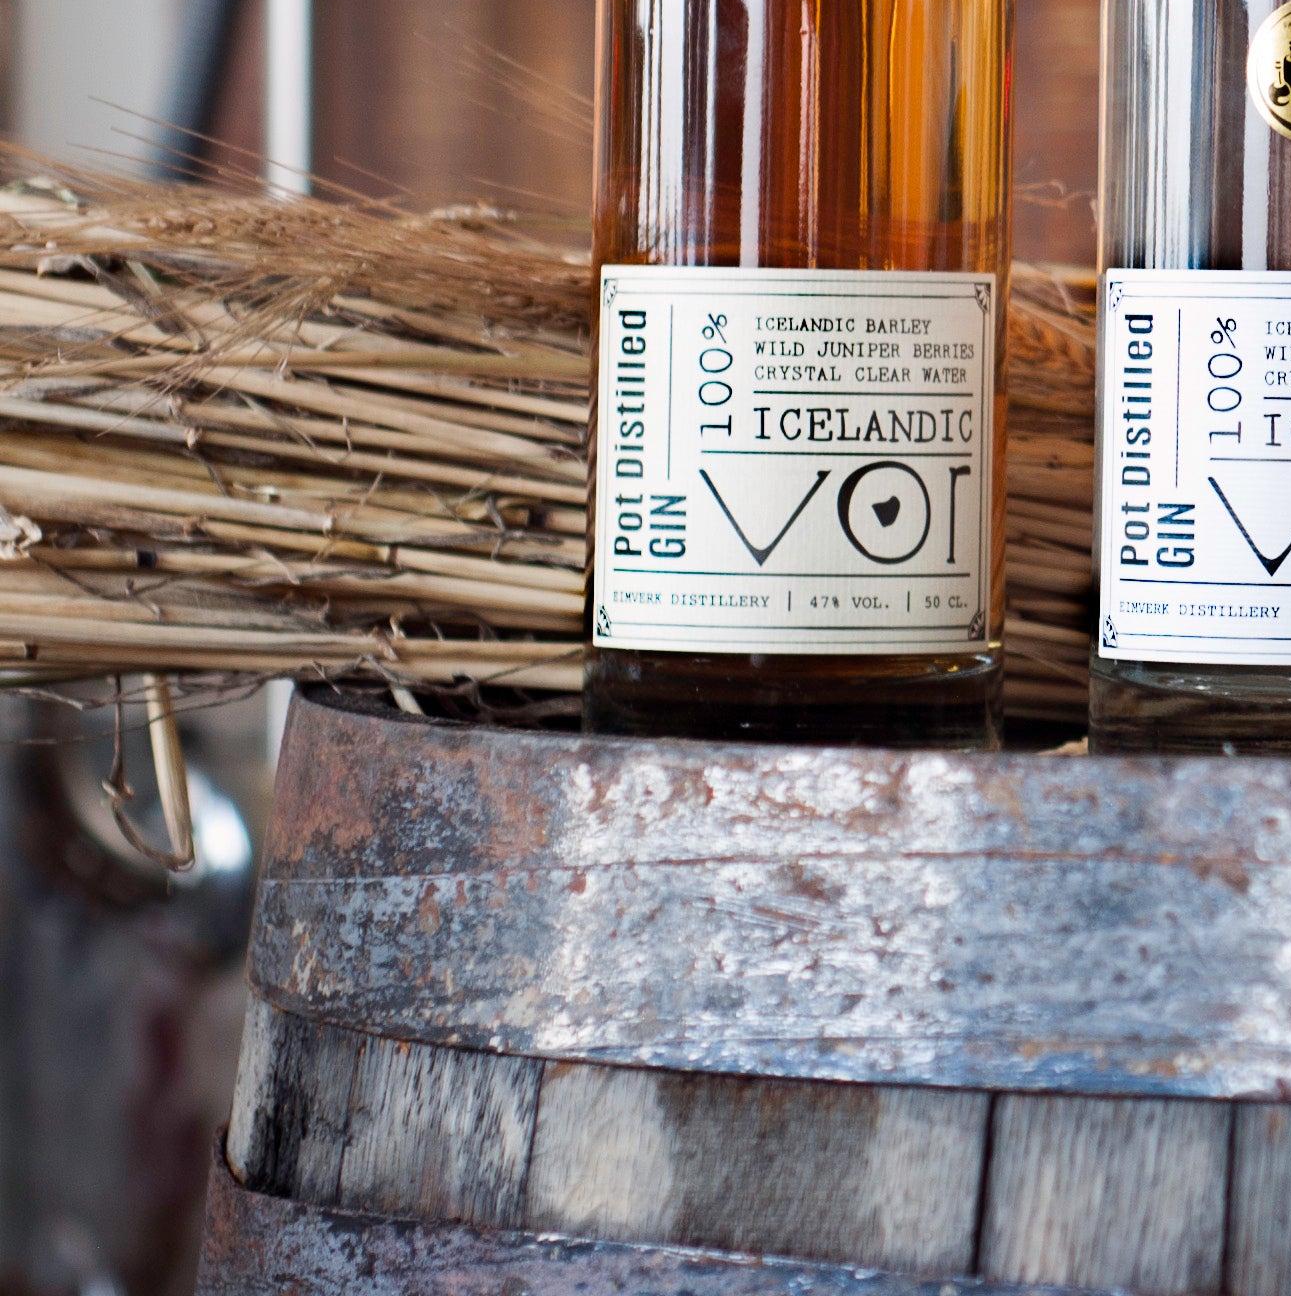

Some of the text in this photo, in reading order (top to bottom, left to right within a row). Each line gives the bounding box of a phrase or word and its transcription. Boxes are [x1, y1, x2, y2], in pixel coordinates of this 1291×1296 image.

[753, 341, 975, 360] WILD JUNIPER BERRIES
[756, 316, 932, 336] ICELANDIC BARLEY
[698, 312, 734, 437] 100%
[754, 365, 967, 384] CRYSTAL CLEAR WATER
[1207, 316, 1243, 445] 100%
[614, 310, 648, 557] Pot Distilled
[755, 407, 973, 443] ICELANDIC
[1120, 313, 1153, 566] Pot Distilled
[649, 494, 687, 558] GIN
[1156, 502, 1196, 568] GIN
[613, 590, 662, 605] EIMVERK
[671, 593, 770, 609] DISTILLERY
[810, 596, 840, 609] 47%
[852, 596, 890, 610] VOL.
[924, 597, 940, 609] 50
[1119, 600, 1170, 615] EIMVERK
[1179, 603, 1281, 619] DISTILLERY
